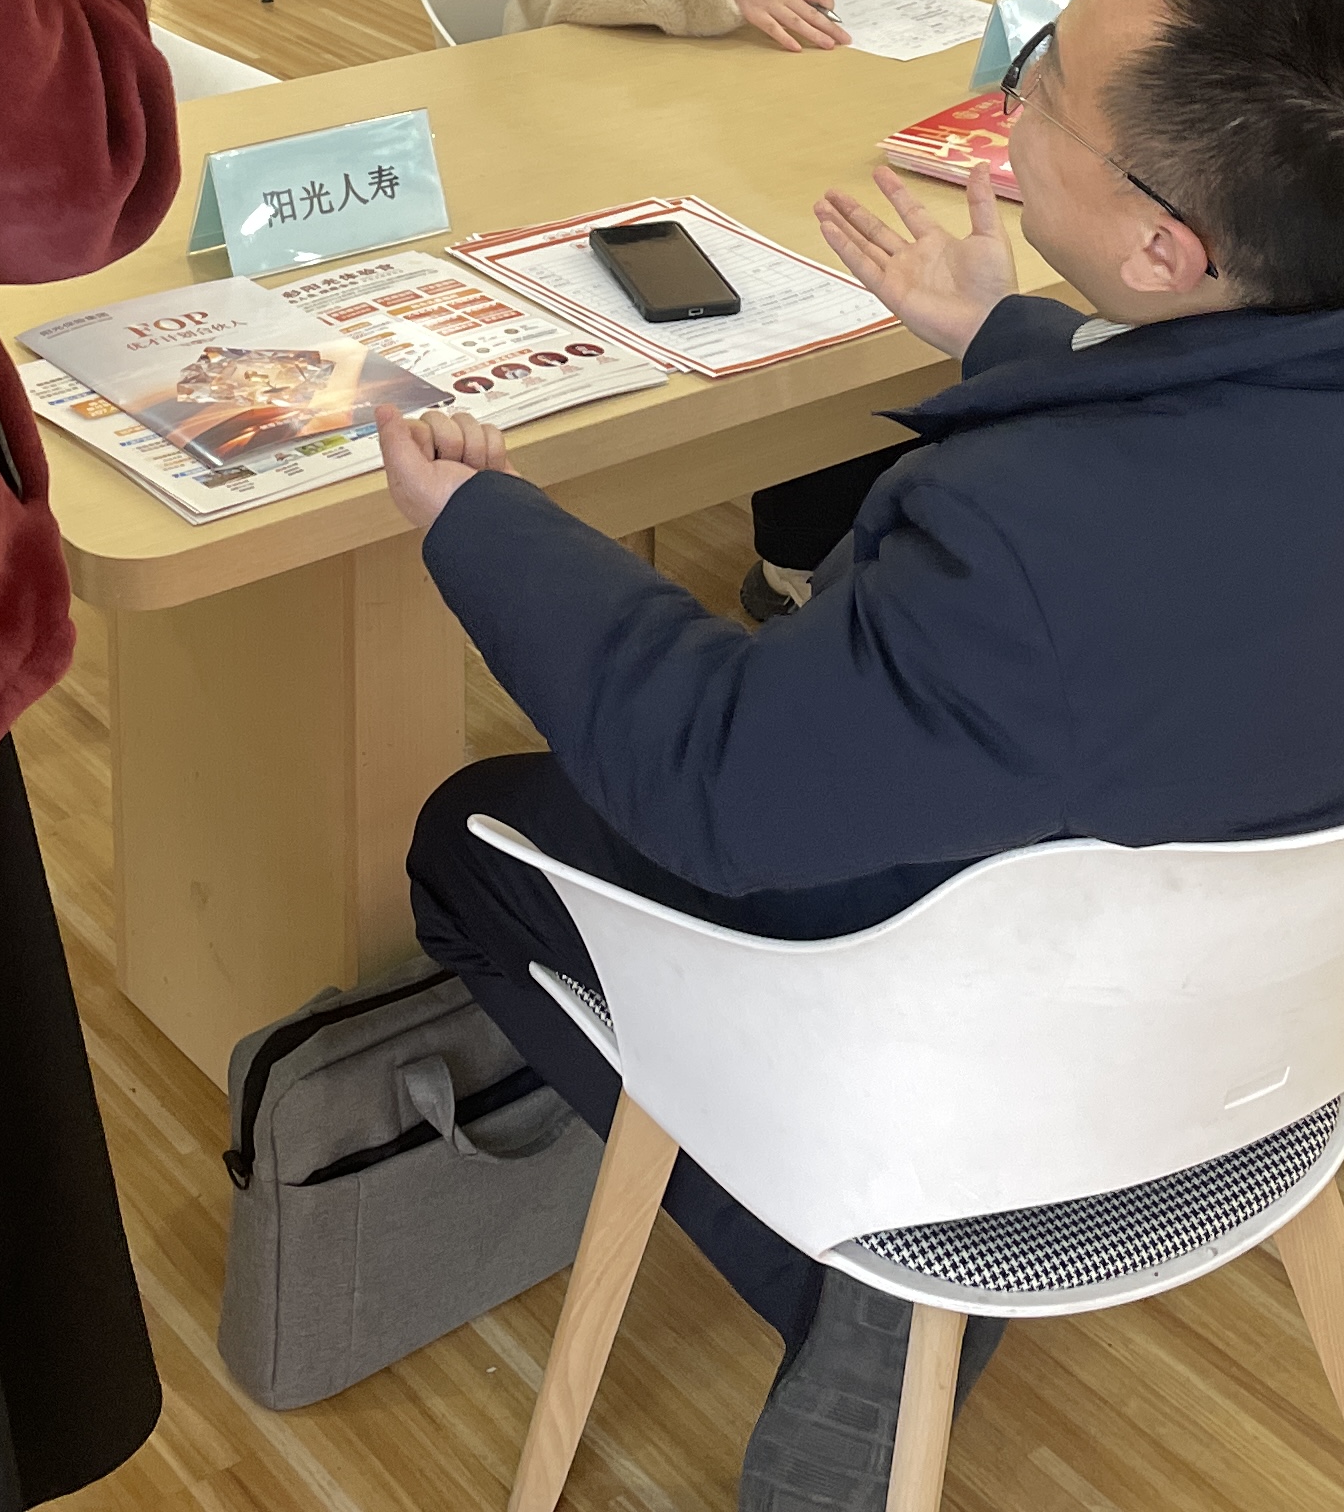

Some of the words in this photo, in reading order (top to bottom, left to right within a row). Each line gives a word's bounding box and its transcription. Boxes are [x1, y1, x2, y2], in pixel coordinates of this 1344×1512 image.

[262, 164, 400, 228] 阳光人寿
[124, 311, 209, 338] FOP
